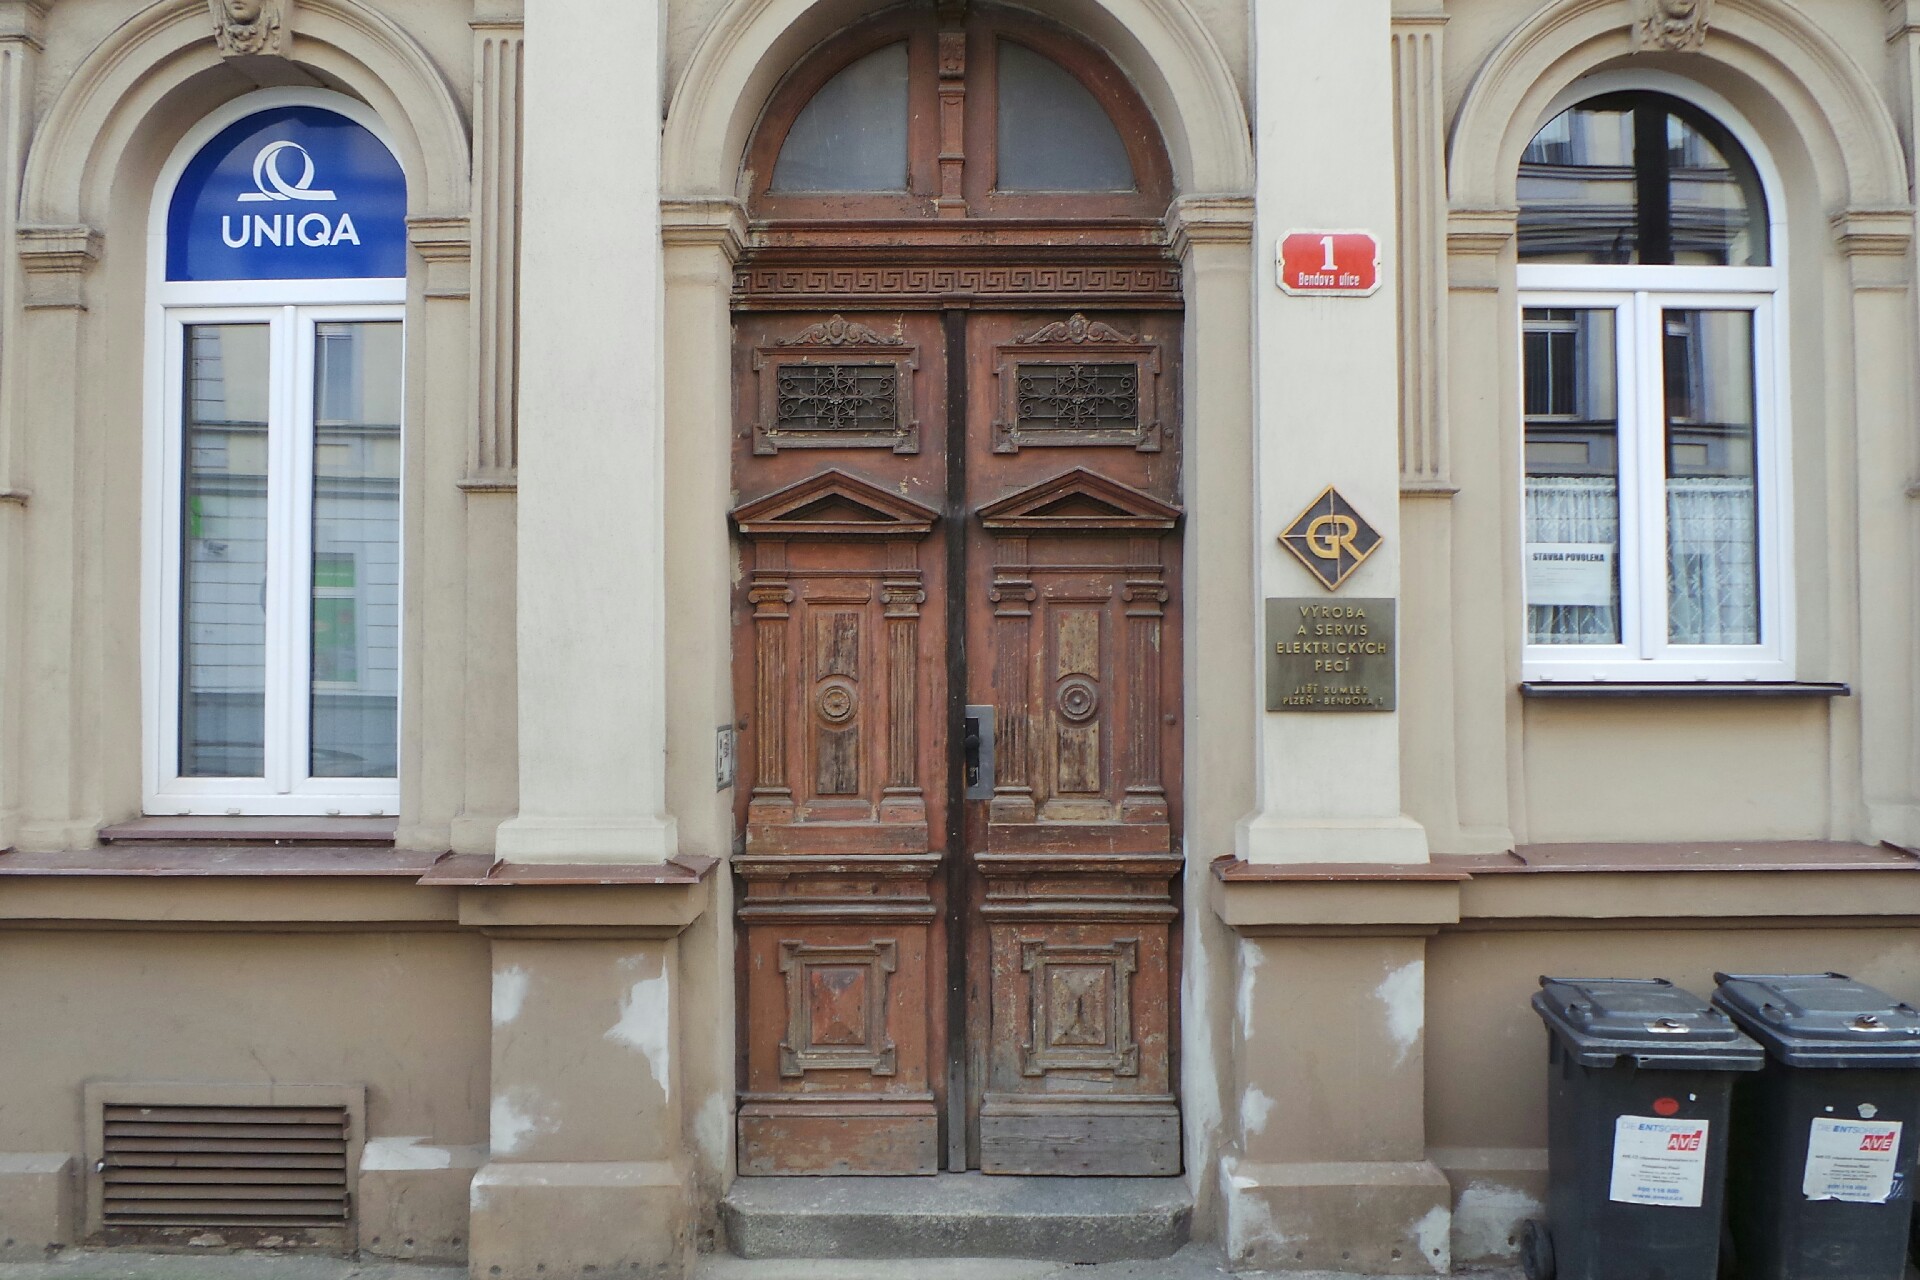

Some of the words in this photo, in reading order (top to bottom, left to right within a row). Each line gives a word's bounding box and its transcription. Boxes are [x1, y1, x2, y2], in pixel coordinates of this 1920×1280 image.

[222, 213, 360, 248] UNIQA
[1320, 236, 1338, 270] 1
[1298, 272, 1334, 286] Bendova
[1339, 272, 1360, 286] ulice
[1533, 552, 1564, 561] STAVBA
[1565, 552, 1605, 562] POVOLENA
[1300, 604, 1366, 618] VÝROBA
[1297, 625, 1307, 636] A
[1315, 624, 1368, 636] SERVIS
[1276, 639, 1386, 655] ELEKTRICKÝCH
[1314, 658, 1350, 672] PECÍ
[1282, 694, 1314, 705] PLZEŇ
[1668, 1135, 1701, 1150] AVE
[1860, 1136, 1893, 1150] AVE
